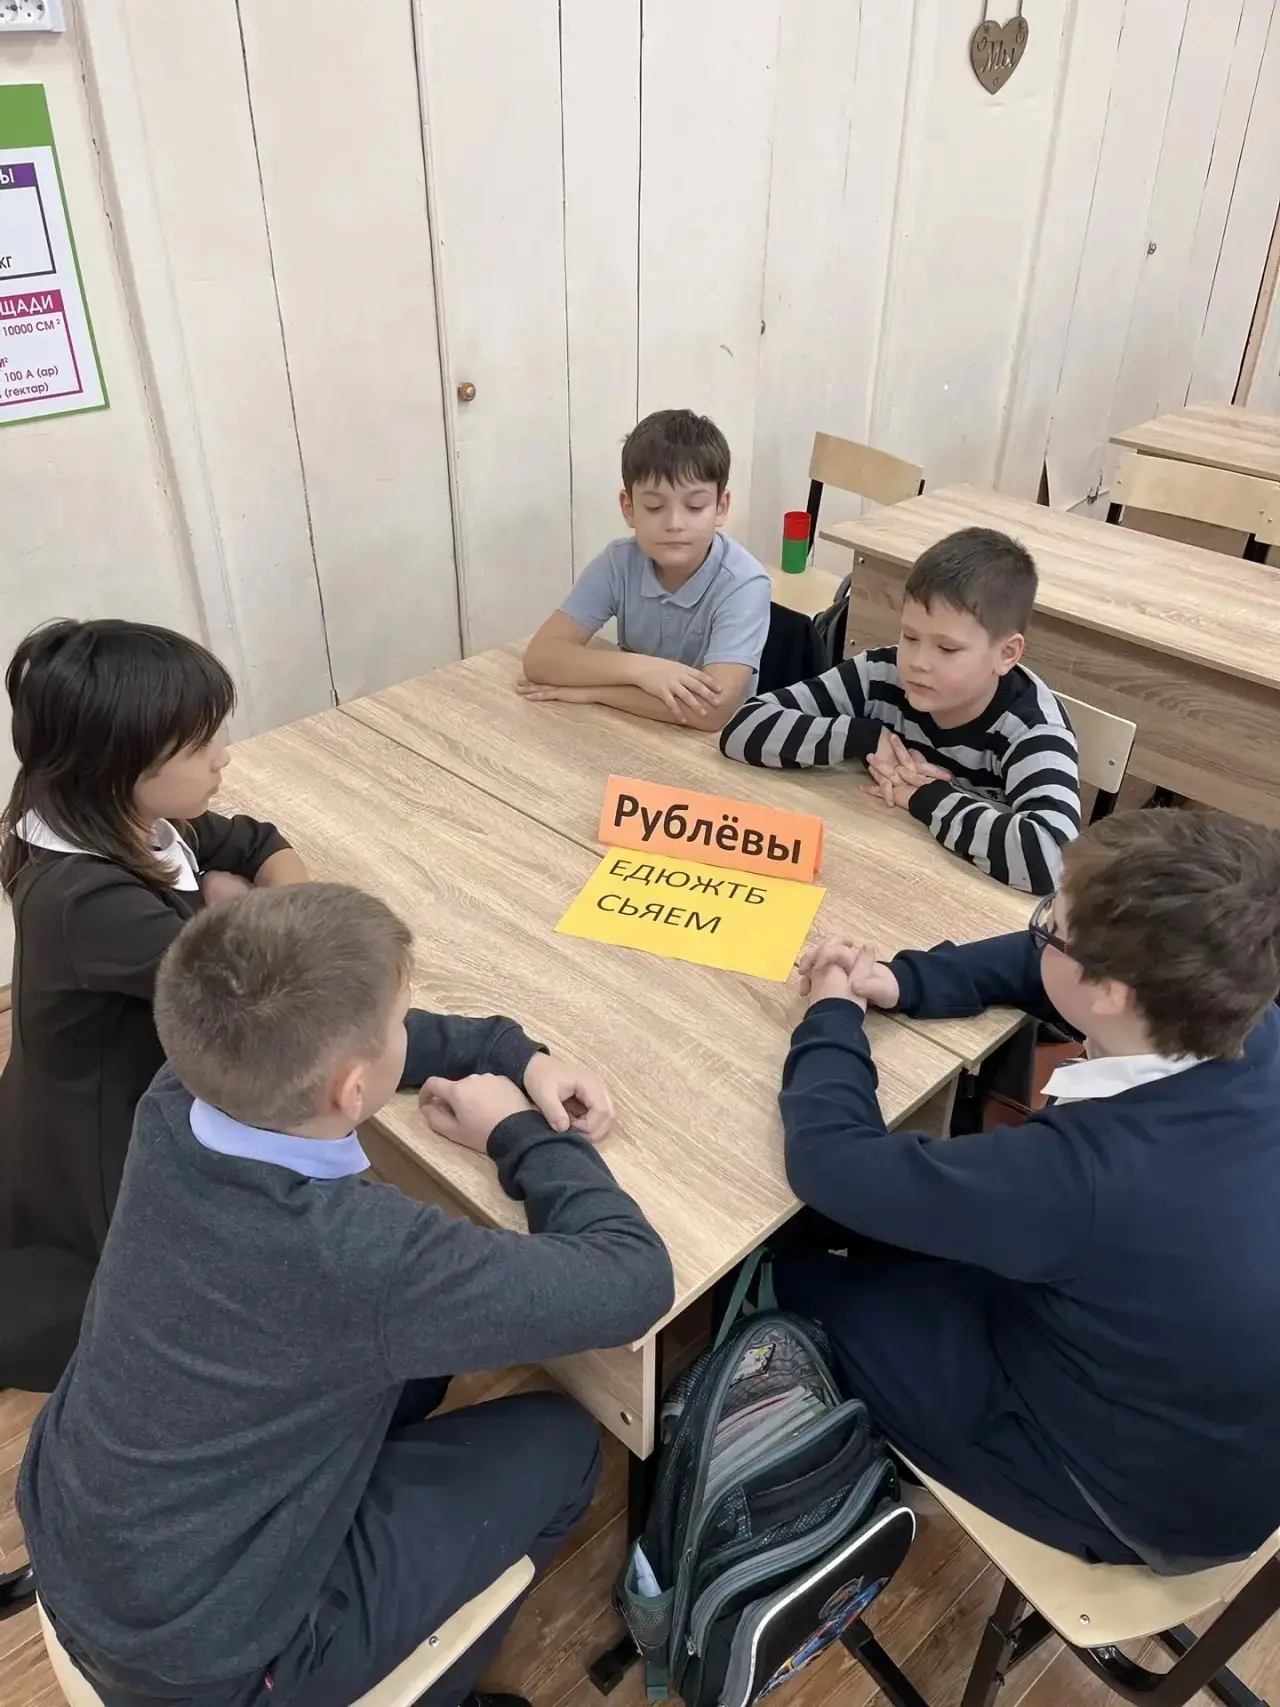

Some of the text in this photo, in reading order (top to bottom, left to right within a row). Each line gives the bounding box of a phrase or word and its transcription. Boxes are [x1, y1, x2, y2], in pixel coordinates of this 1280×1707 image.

[2, 323, 33, 336] 10000
[4, 365, 59, 382] 100 А (ар)
[4, 382, 49, 399] (гектар)
[614, 794, 801, 864] Рублёвы
[609, 859, 767, 905] ЕДЮЖТБ
[597, 894, 722, 934] СЬЯЕМ
